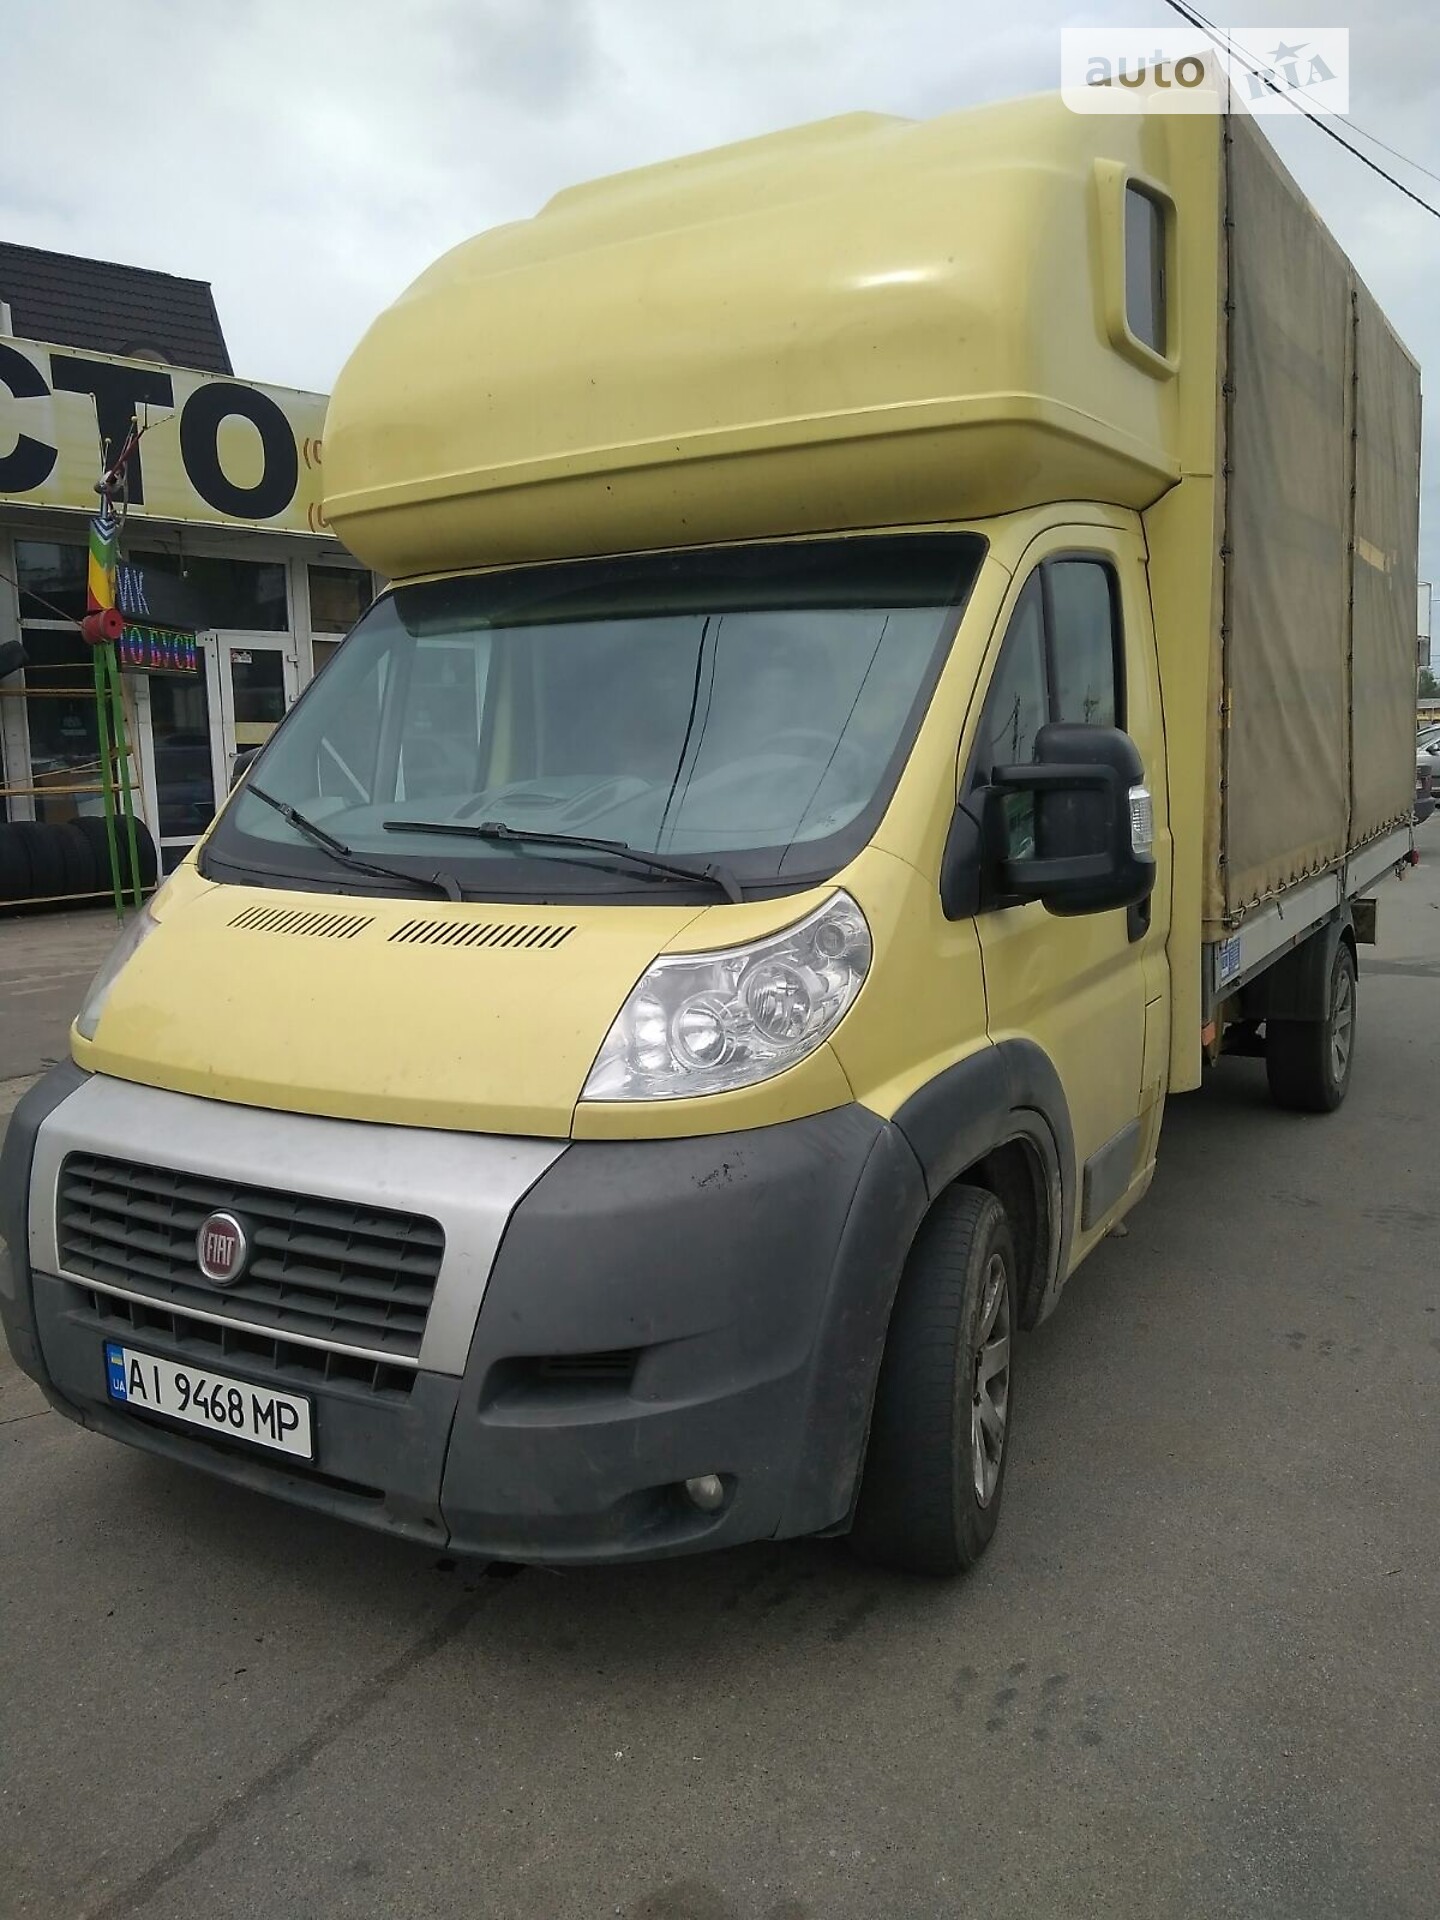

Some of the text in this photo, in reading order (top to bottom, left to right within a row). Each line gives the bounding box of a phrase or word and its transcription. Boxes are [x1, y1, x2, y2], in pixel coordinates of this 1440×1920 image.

[207, 1233, 235, 1266] FIAT
[113, 1378, 126, 1393] UA
[174, 1373, 244, 1429] 9468
[252, 1393, 299, 1442] MP
